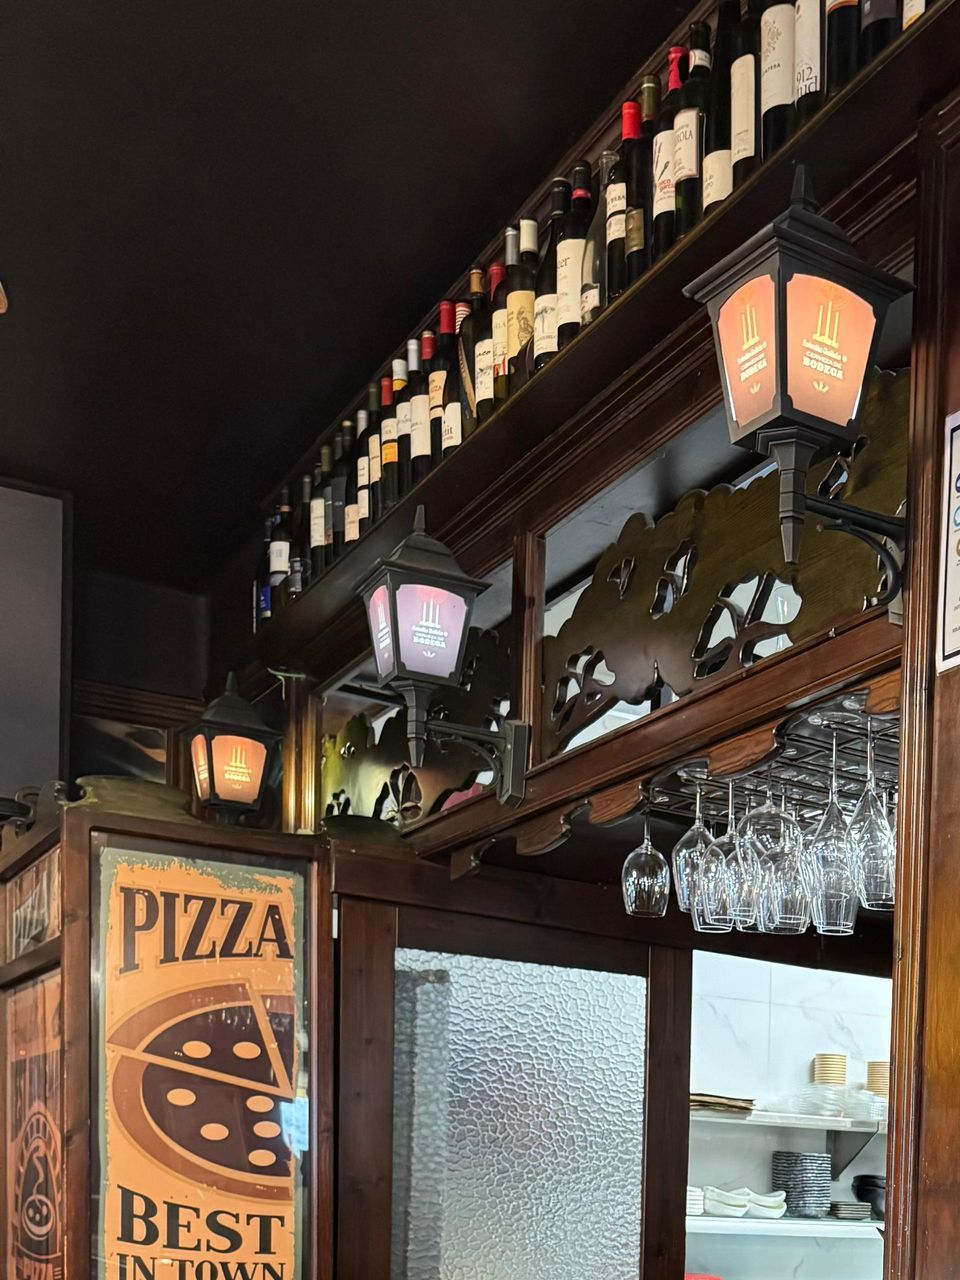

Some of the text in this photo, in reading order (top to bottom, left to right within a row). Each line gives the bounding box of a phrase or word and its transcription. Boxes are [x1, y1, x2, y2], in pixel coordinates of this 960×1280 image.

[802, 355, 844, 380] BODEGA
[118, 885, 294, 975] PIZZA
[116, 1184, 286, 1255] BEST
